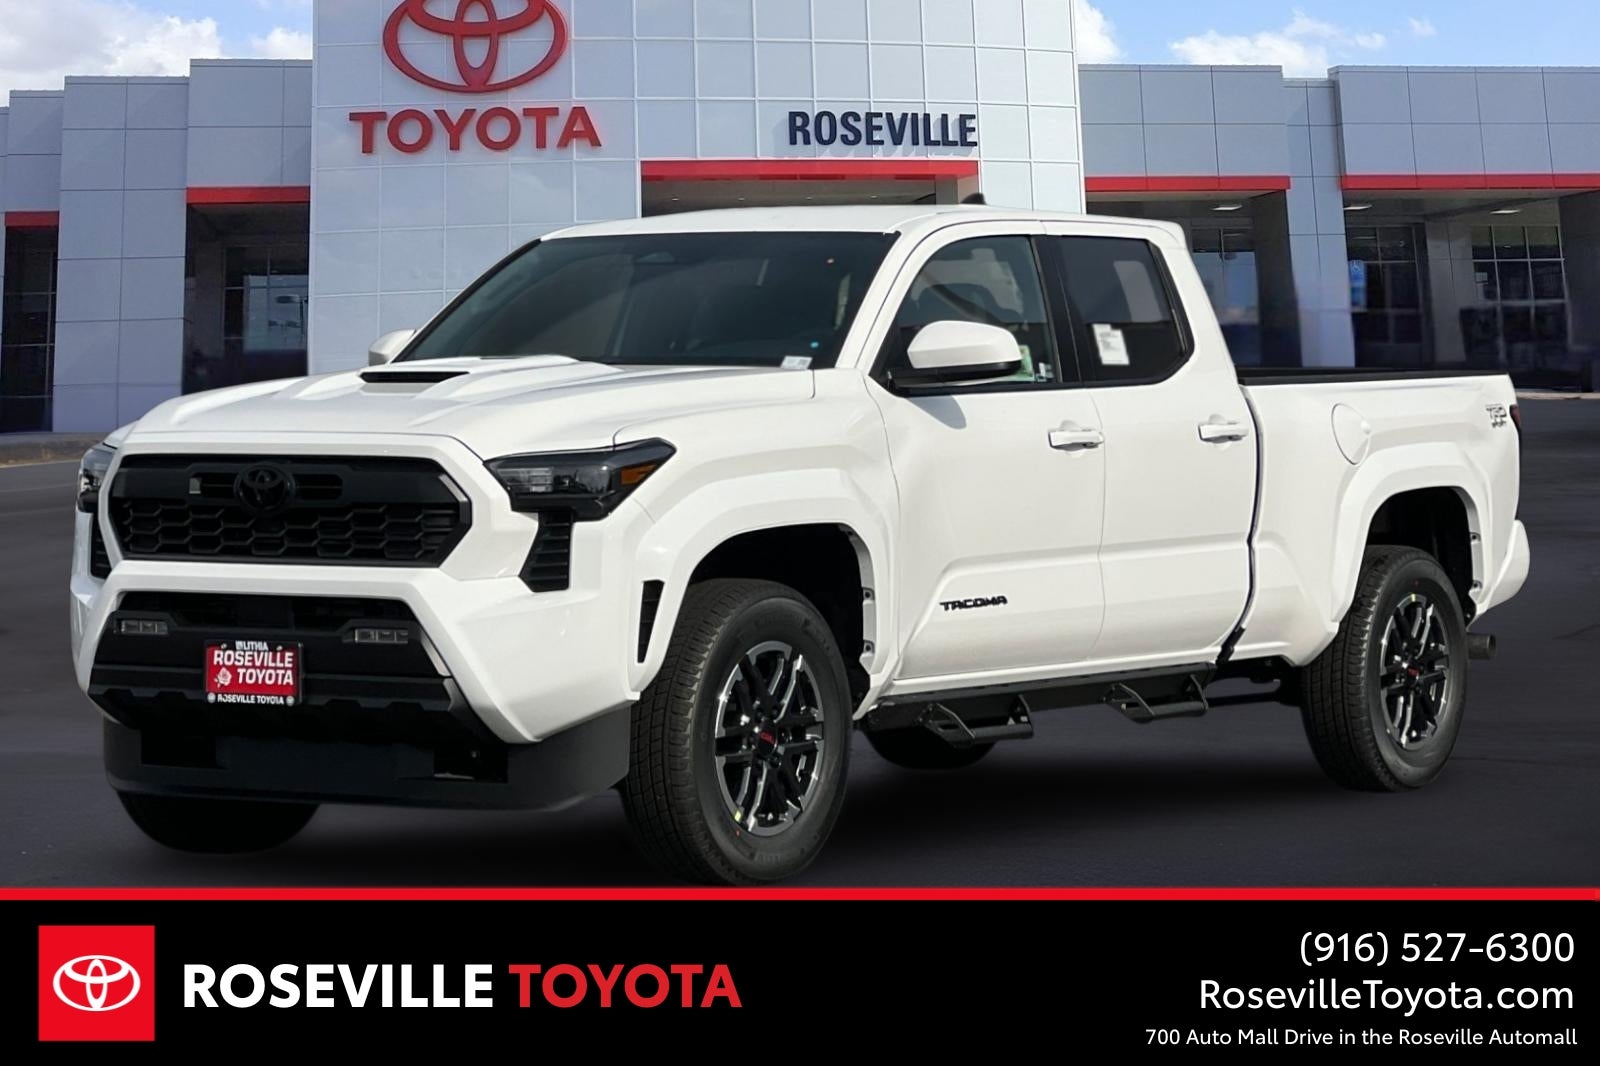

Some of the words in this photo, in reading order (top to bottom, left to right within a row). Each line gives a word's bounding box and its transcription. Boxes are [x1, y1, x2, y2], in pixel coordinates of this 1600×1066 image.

[349, 106, 602, 154] TOYOTA
[788, 110, 979, 147] ROSEVILLE
[940, 595, 1008, 611] TACOMA
[243, 641, 269, 651] LITHIA
[213, 650, 294, 667] ROSEVILLE
[237, 668, 294, 685] TOYOTA
[217, 693, 256, 704] ROSEVILLE
[257, 695, 284, 705] TOYOTA
